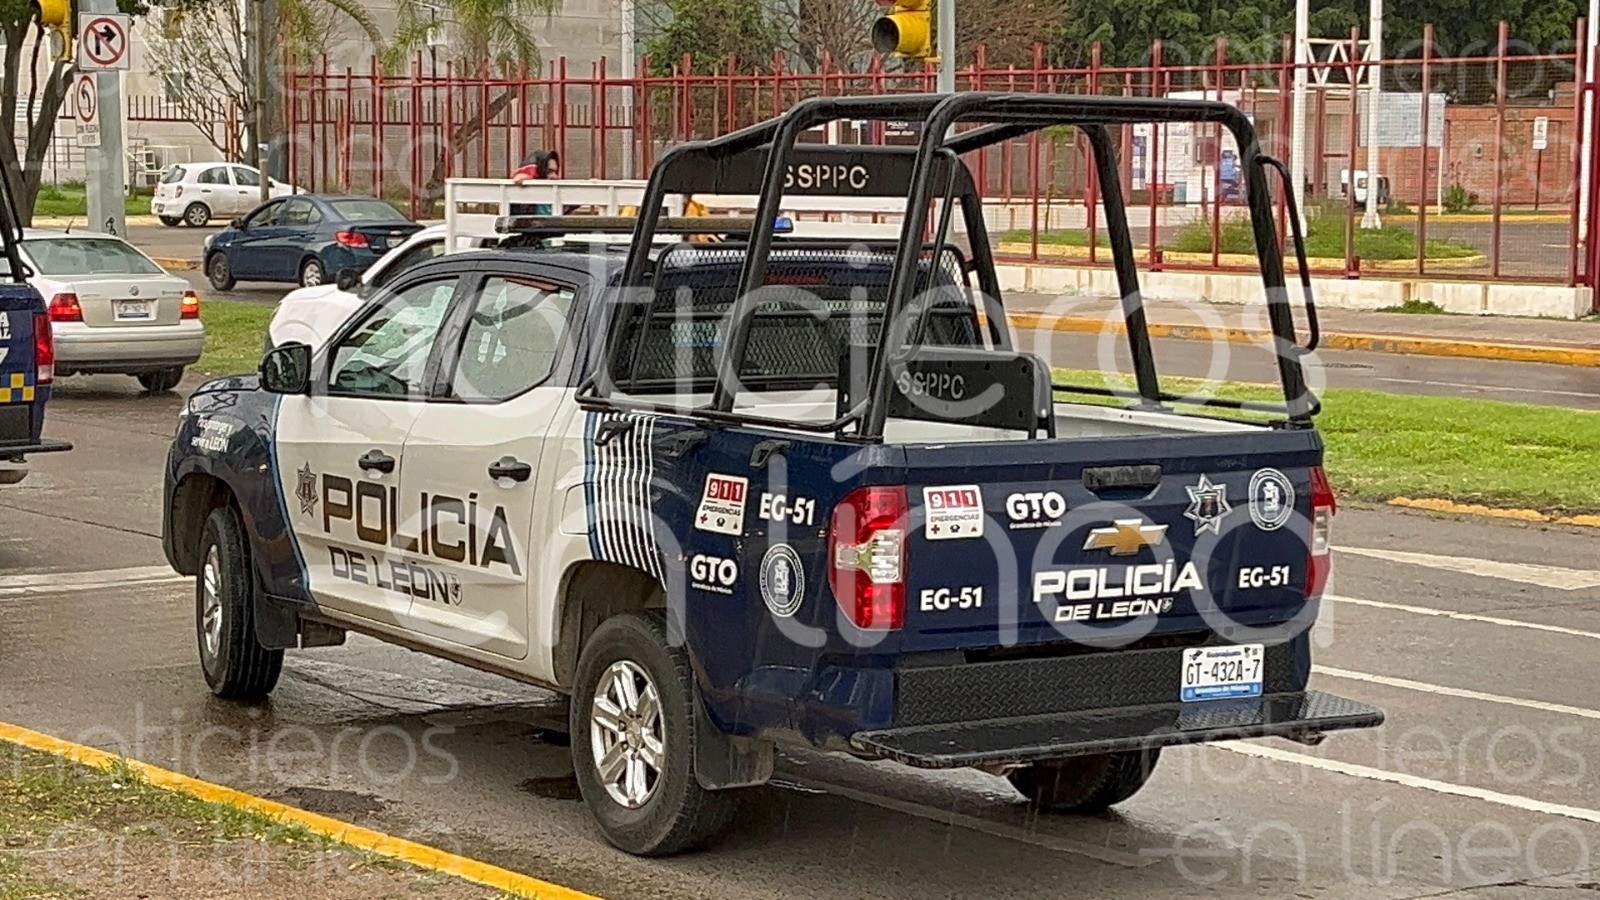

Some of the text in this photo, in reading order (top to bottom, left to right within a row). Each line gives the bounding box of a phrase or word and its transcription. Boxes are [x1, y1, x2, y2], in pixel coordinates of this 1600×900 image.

[784, 164, 866, 189] SSPPC
[898, 370, 964, 399] SSPPC
[708, 479, 743, 502] 911
[930, 491, 976, 508] 911
[702, 504, 741, 516] EMERGENCIAS
[759, 492, 815, 526] EG-51
[930, 513, 980, 523] EMERGENCIAS
[1006, 492, 1066, 520] GTO
[322, 473, 522, 576] POLICÍA
[327, 546, 450, 604] DE LEÓN
[690, 554, 738, 585] GTO
[1033, 559, 1203, 602] POLICÍA
[1238, 565, 1290, 589] EG-51
[920, 586, 983, 611] EG-51
[1055, 598, 1163, 621] DE LEÓN
[1186, 659, 1260, 685] GT-432A-7
